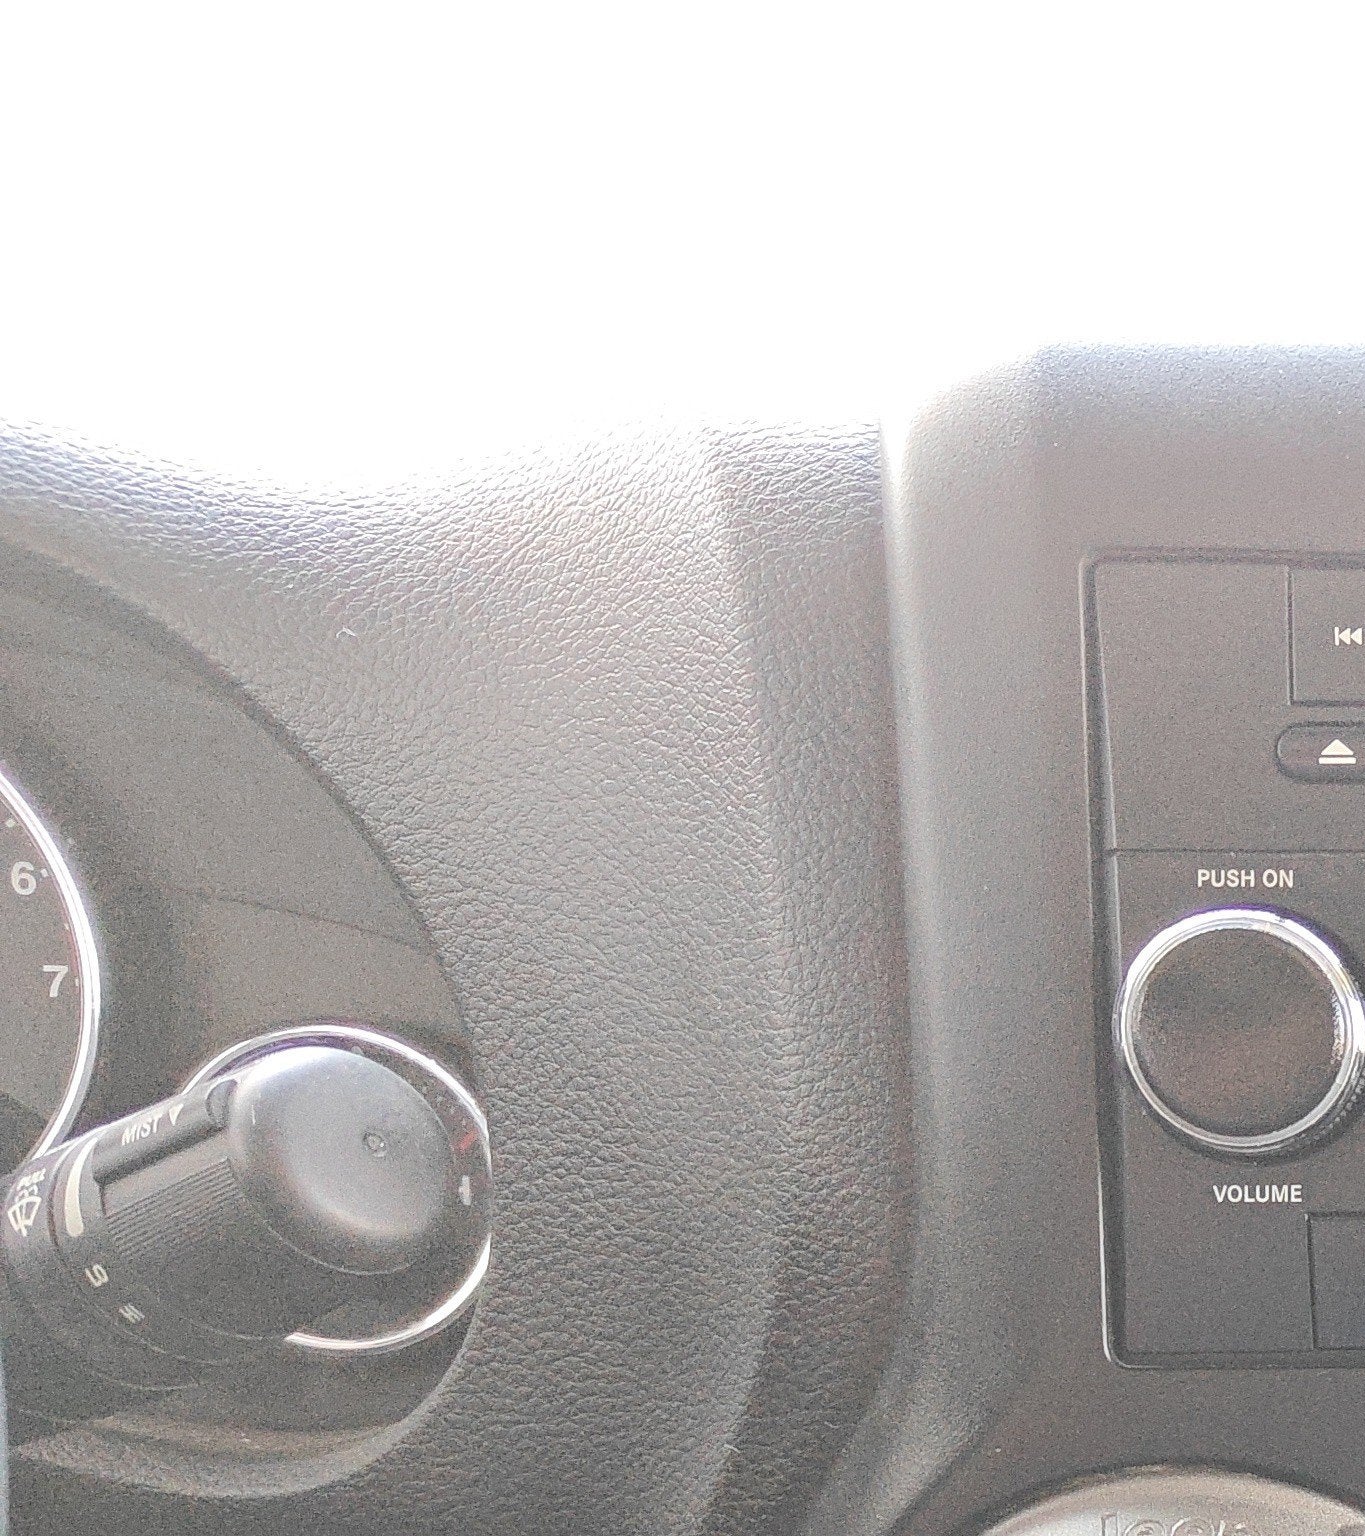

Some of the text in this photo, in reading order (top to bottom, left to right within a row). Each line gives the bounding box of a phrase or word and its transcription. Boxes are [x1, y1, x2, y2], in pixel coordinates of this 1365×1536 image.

[11, 861, 36, 896] 6
[1197, 868, 1294, 888] PUSH ON
[43, 964, 69, 998] 7
[121, 1114, 163, 1146] MIST
[1212, 1184, 1303, 1203] VOLUME
